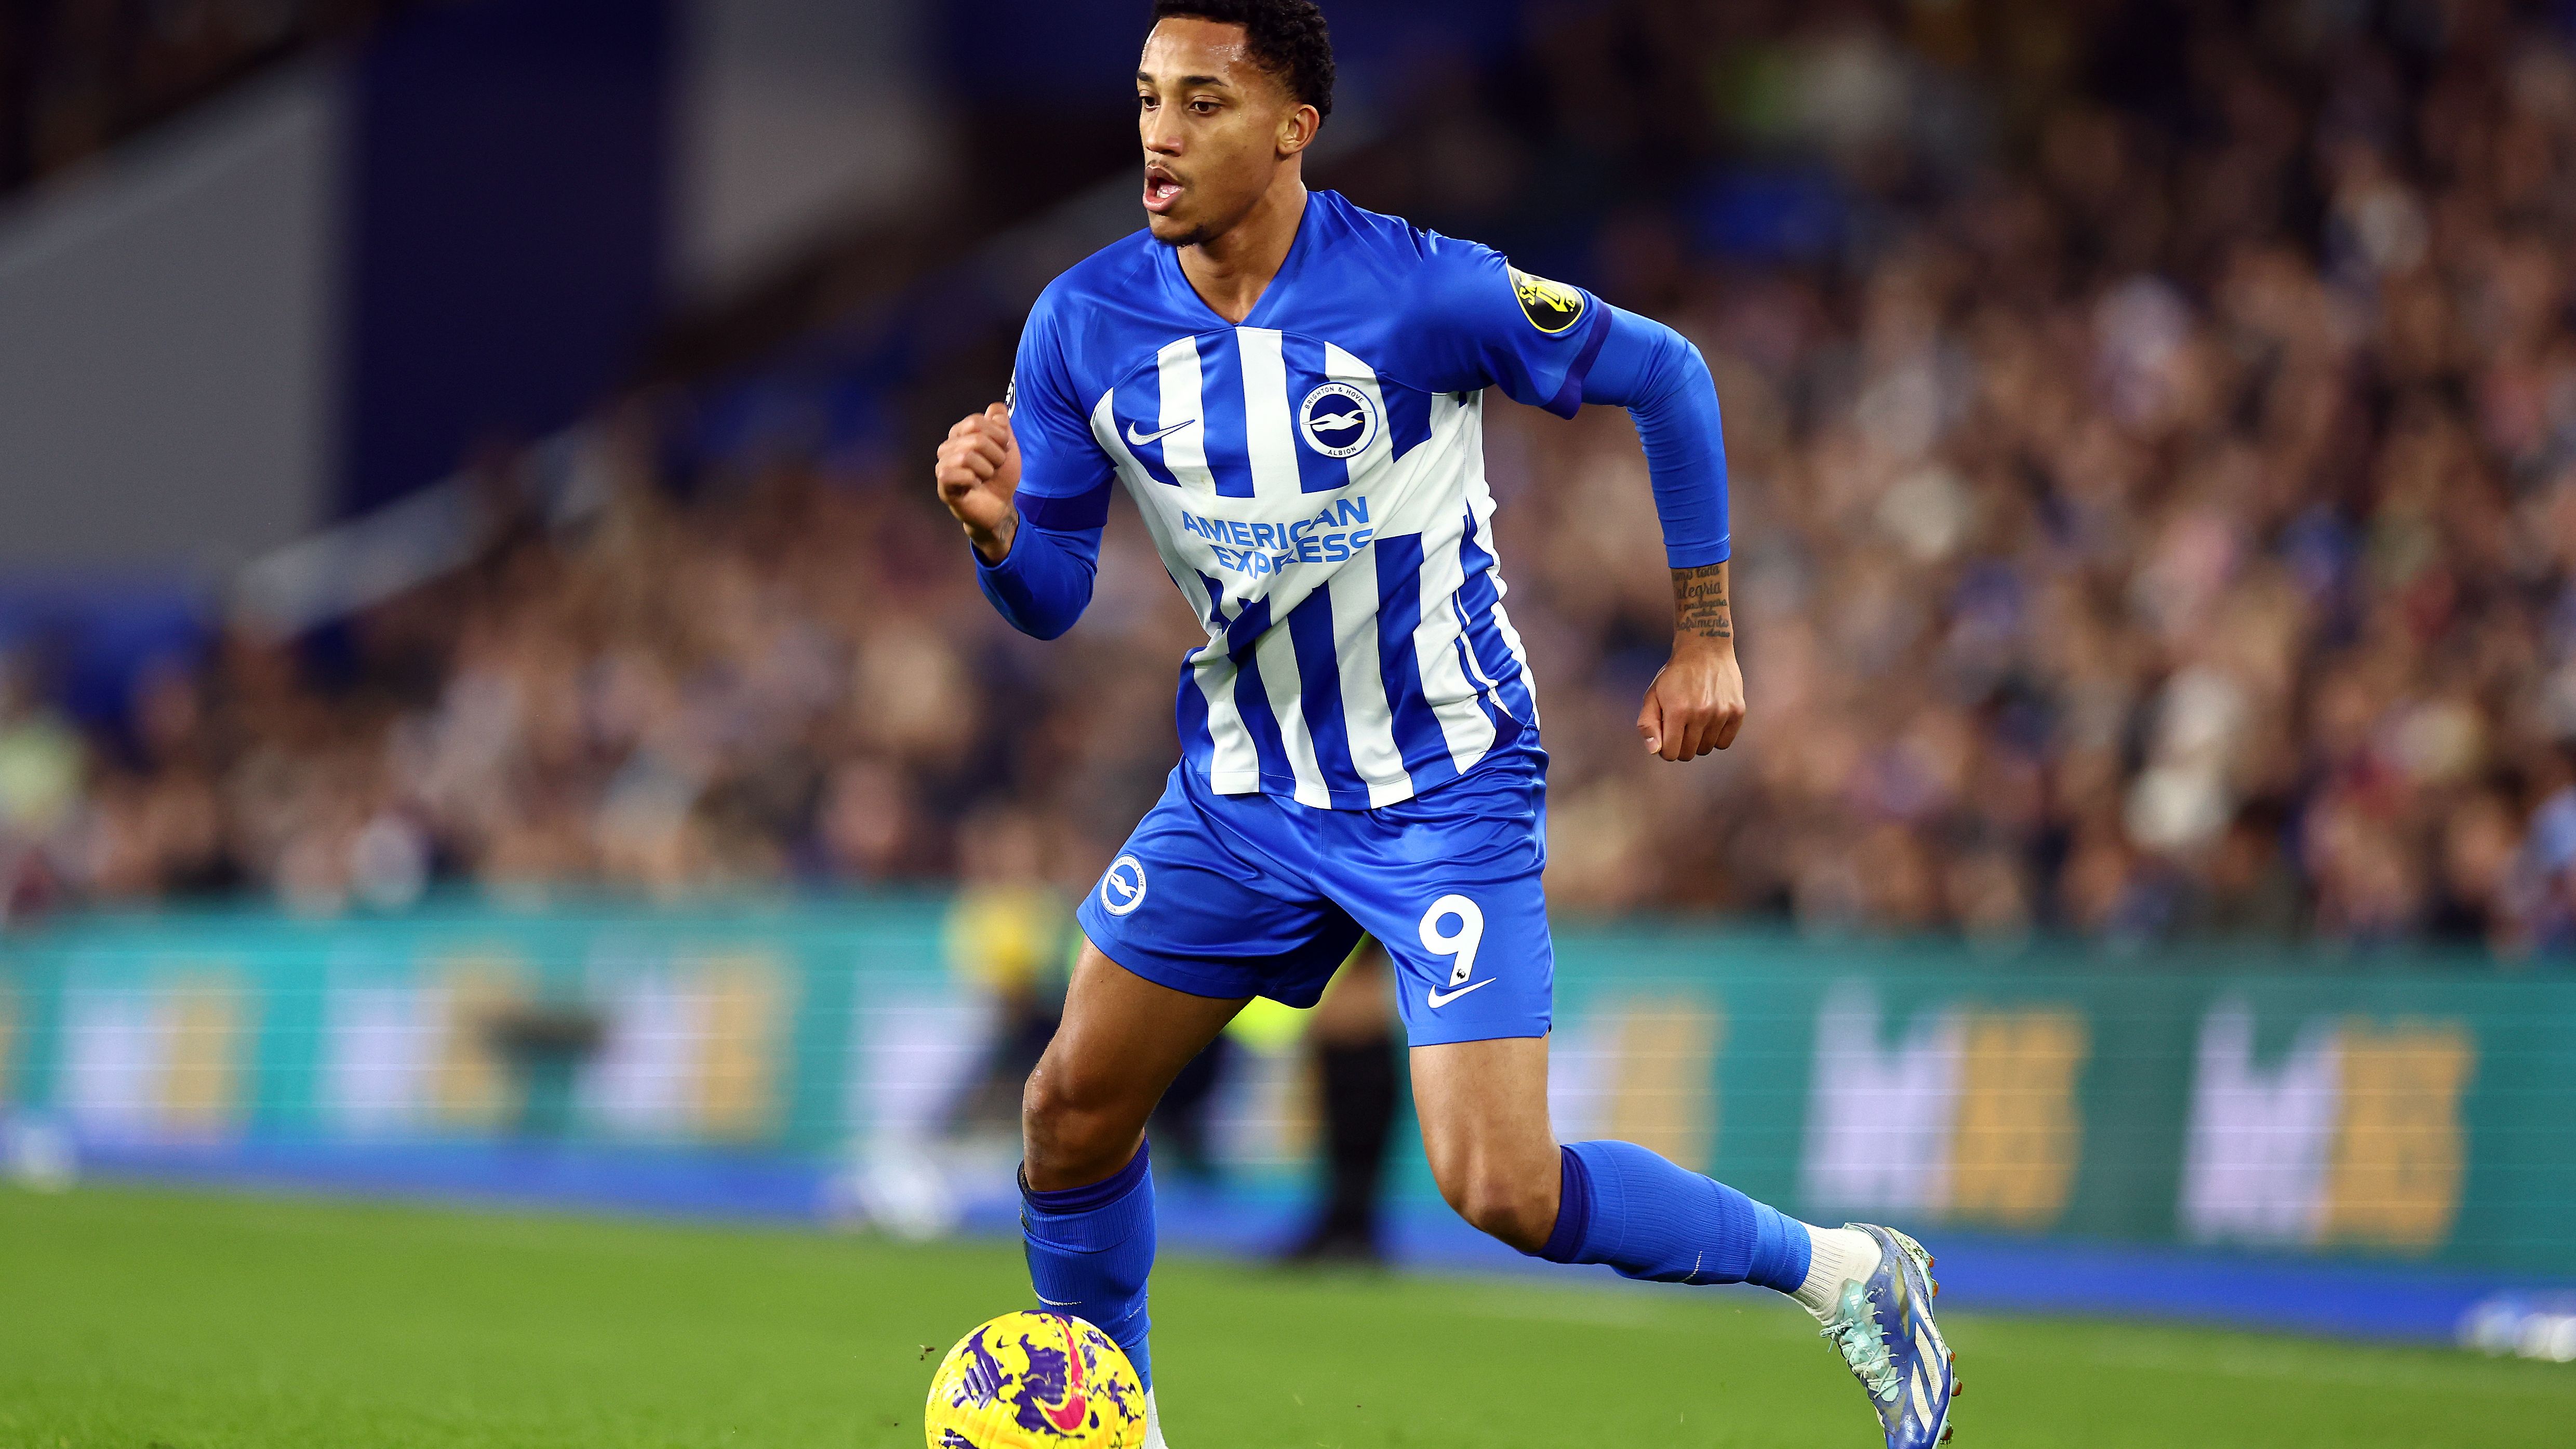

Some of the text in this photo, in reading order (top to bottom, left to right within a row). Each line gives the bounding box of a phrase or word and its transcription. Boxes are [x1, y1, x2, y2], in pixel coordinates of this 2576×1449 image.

[1305, 387, 1334, 409] BRIGHTON
[1346, 389, 1364, 403] HOVE
[1328, 446, 1357, 456] ALBION
[1182, 496, 1369, 550] AMERICAN
[1419, 894, 1484, 987] 9
